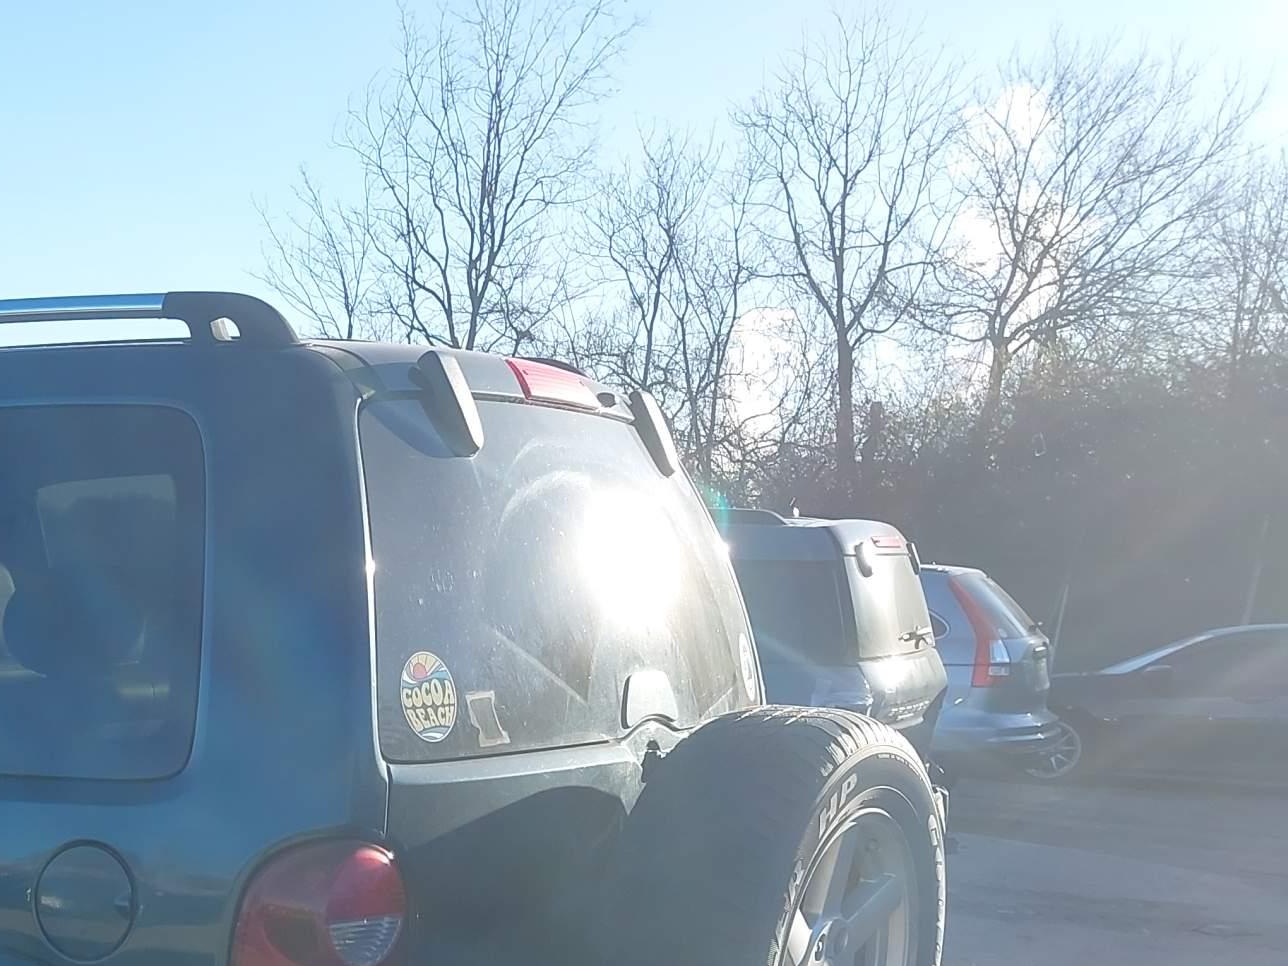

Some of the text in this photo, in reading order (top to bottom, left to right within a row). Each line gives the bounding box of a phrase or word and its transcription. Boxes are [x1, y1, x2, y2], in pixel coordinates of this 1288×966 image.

[402, 678, 455, 708] COCOA
[406, 704, 455, 732] BEACH
[818, 772, 858, 840] HP
